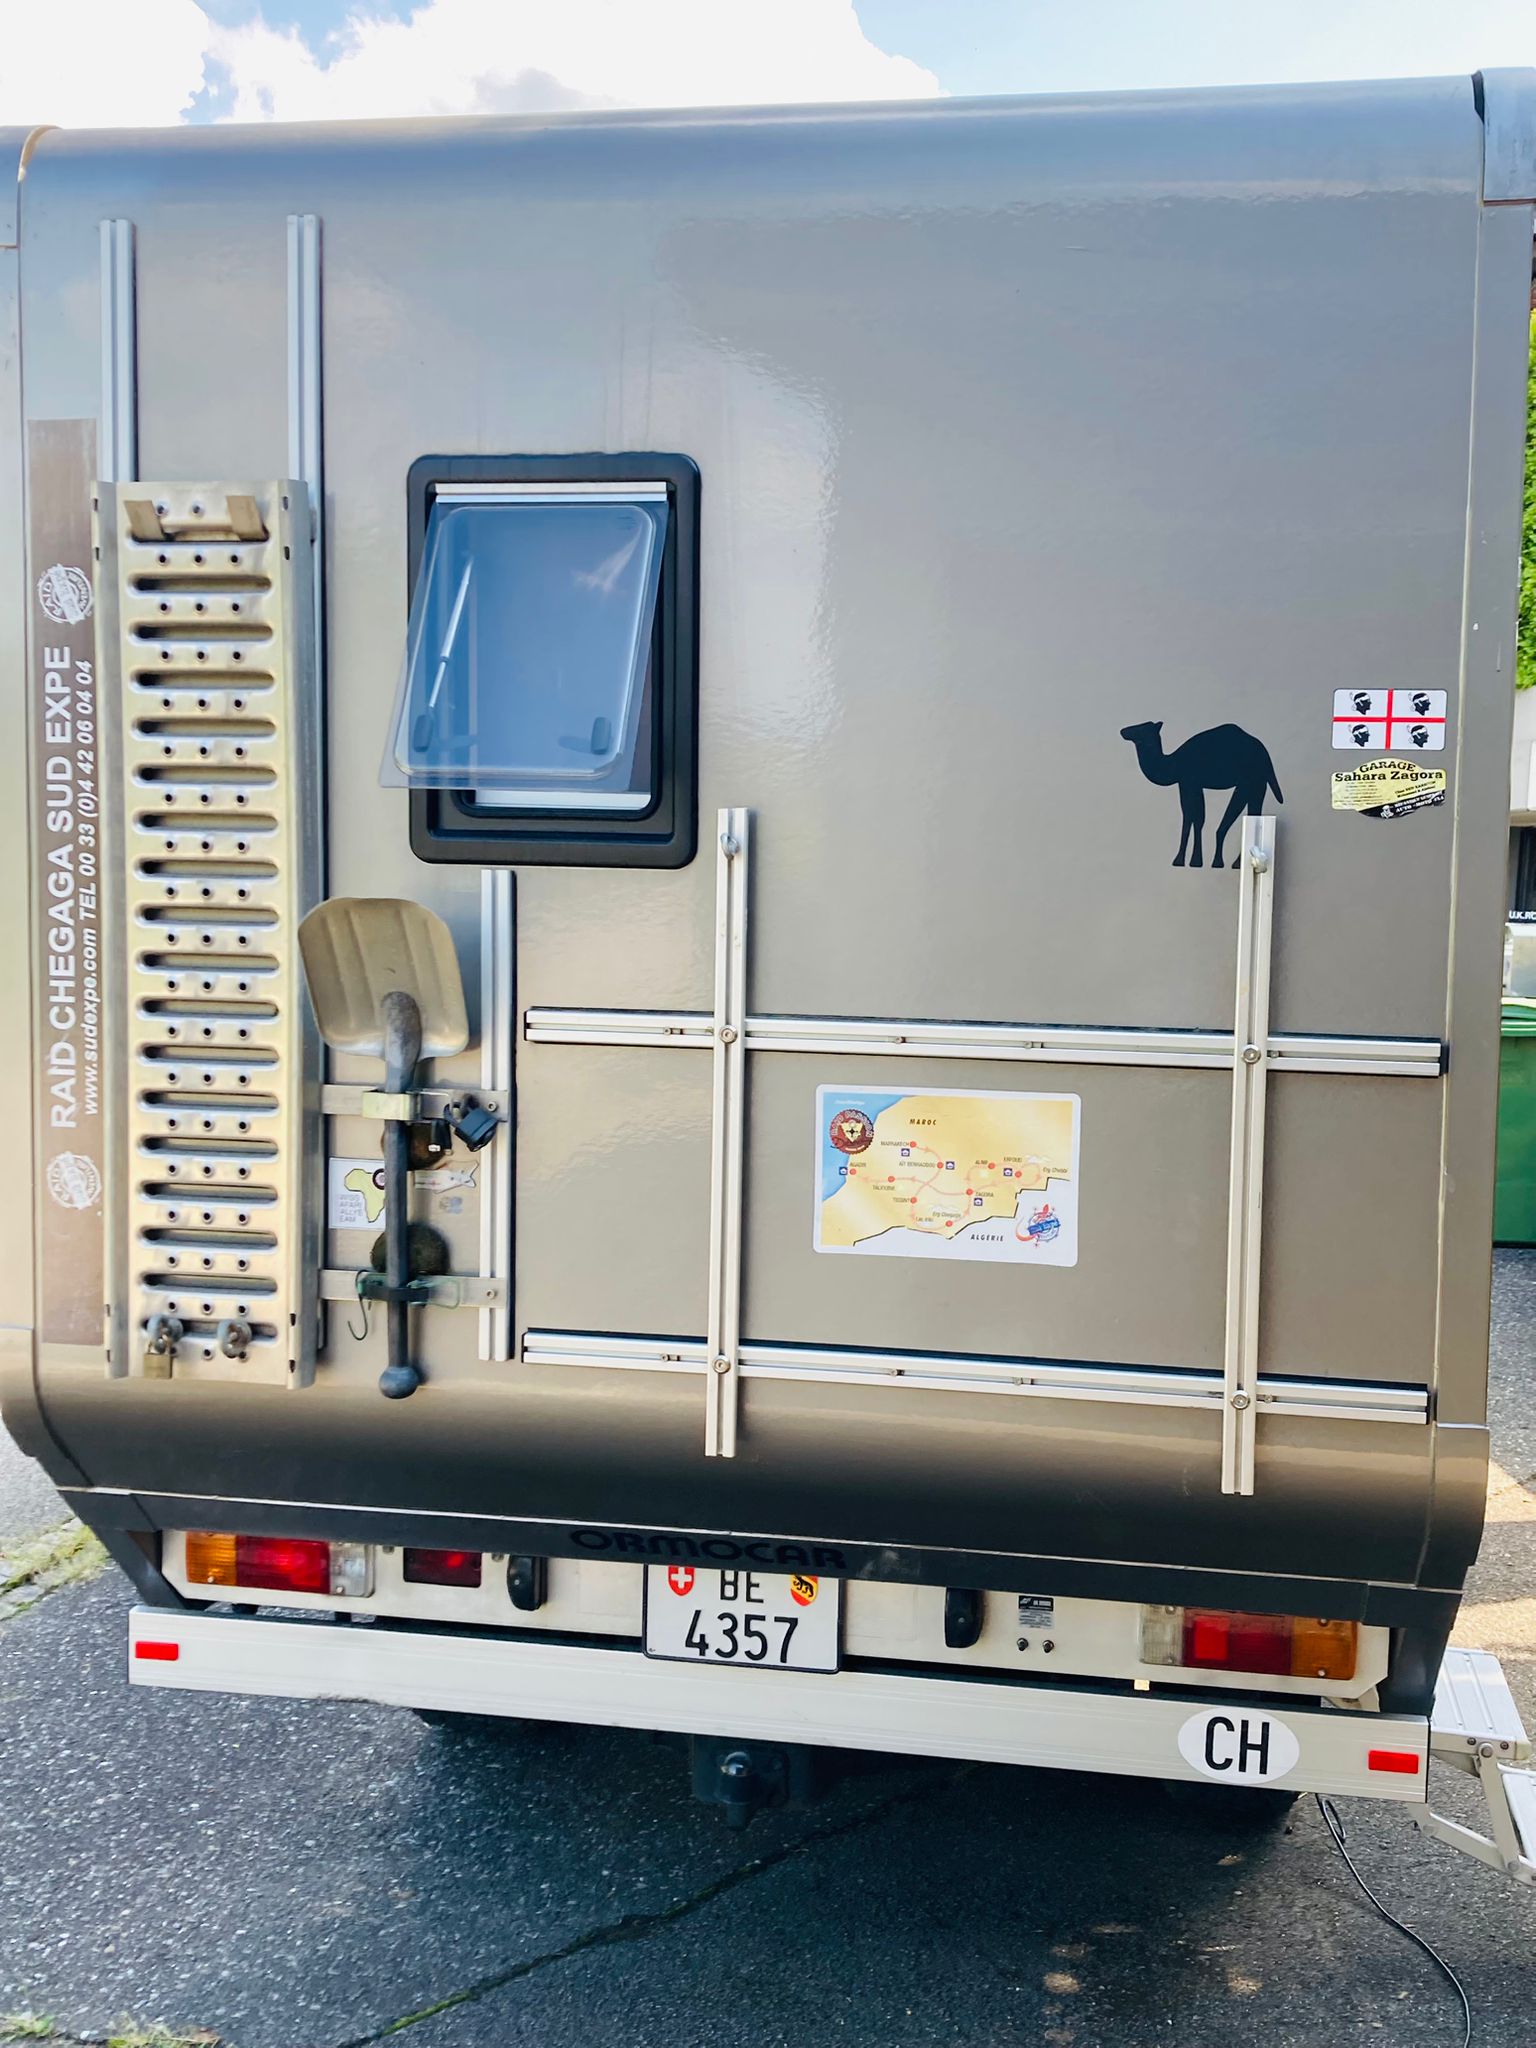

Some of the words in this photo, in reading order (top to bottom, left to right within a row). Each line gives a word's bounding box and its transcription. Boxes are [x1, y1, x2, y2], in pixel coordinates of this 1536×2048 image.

[75, 660, 93, 685] 04
[44, 646, 72, 743] EXPE
[76, 690, 93, 715] 04
[76, 720, 94, 744] 06
[76, 749, 94, 775] 42
[1334, 772, 1386, 782] Sahara
[1390, 770, 1443, 781] Zagora
[1359, 760, 1416, 773] GARAGE
[46, 756, 74, 833] SUD
[77, 779, 99, 818] (0)4
[78, 823, 96, 847] 33
[78, 852, 97, 877] 00
[78, 882, 97, 921] TEL
[47, 843, 76, 1030] CHEGAGA
[80, 928, 101, 1115] www.sudexpe.com
[47, 1041, 77, 1128] RAID
[569, 1528, 847, 1570] ORMOCAR
[720, 1570, 764, 1603] BE
[684, 1609, 799, 1663] 4357
[1203, 1715, 1271, 1775] CH
